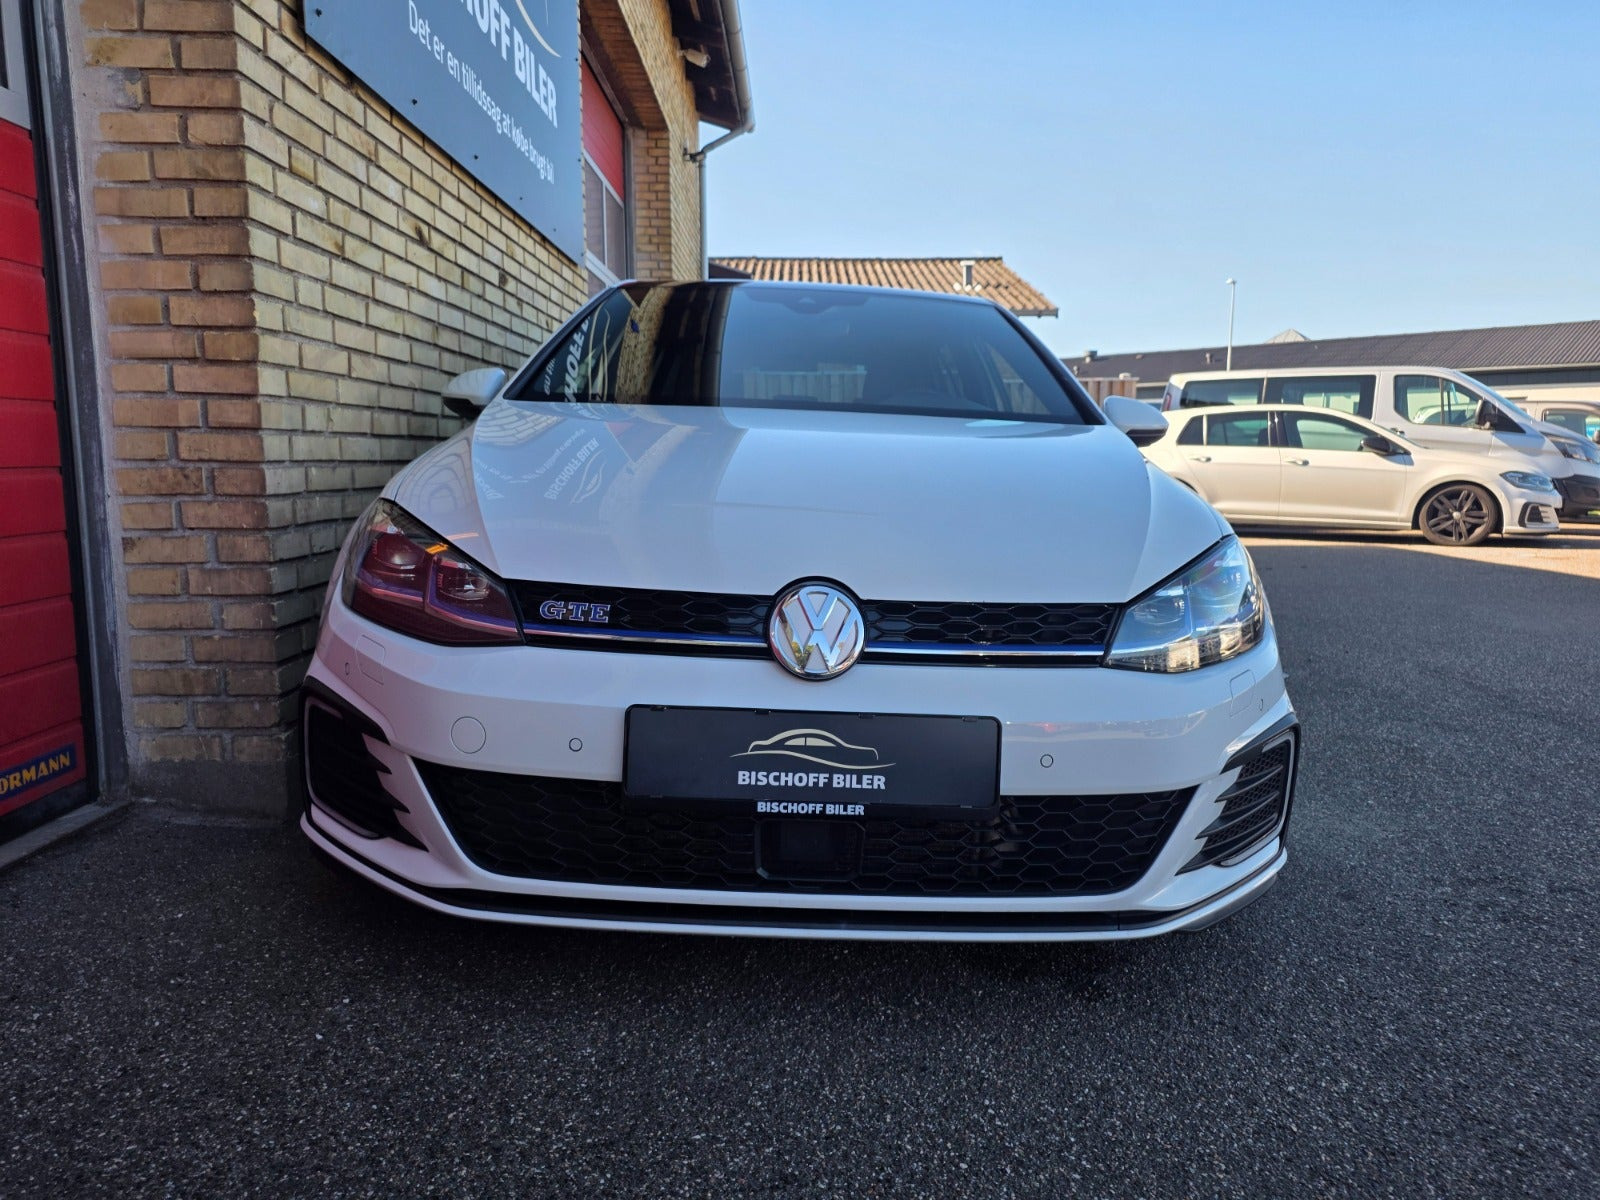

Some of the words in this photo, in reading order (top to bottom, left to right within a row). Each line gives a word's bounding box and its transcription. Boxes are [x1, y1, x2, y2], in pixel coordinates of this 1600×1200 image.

[513, 26, 558, 129] BILER
[408, 0, 432, 51] Det
[433, 35, 445, 64] er
[447, 51, 461, 83] en
[461, 61, 502, 134] tillidssag
[502, 112, 511, 138] at
[529, 137, 547, 180] brugt
[546, 157, 555, 185] bil
[539, 600, 611, 624] GTE
[737, 770, 829, 788] BISCHOFF
[832, 773, 886, 790] BILER
[756, 801, 823, 815] BISCHOFF
[825, 803, 865, 816] BILER
